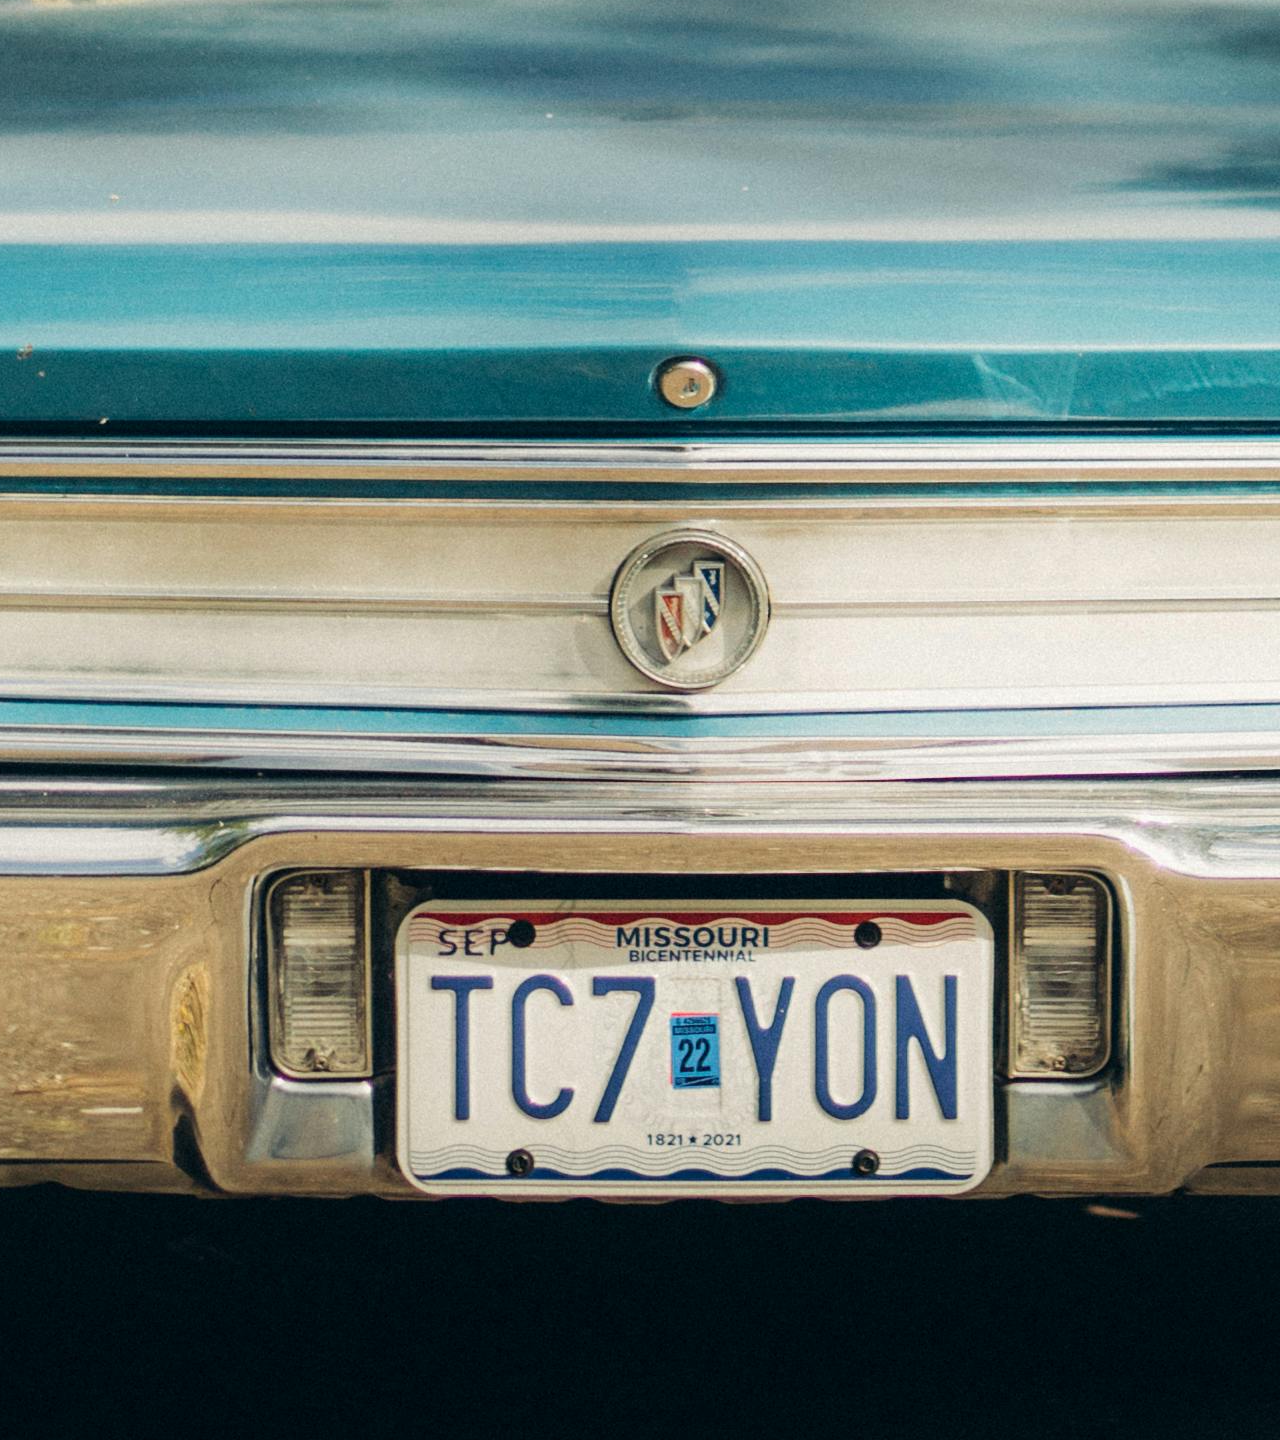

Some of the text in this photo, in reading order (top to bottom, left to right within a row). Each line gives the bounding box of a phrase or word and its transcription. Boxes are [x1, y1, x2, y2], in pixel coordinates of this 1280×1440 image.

[437, 928, 510, 956] SEP
[616, 926, 769, 948] MISSOURI
[629, 949, 756, 963] BICENTENNIAL
[430, 973, 959, 1122] TC7 YON
[678, 1037, 712, 1073] 22
[647, 1134, 742, 1146] 1821 2021
